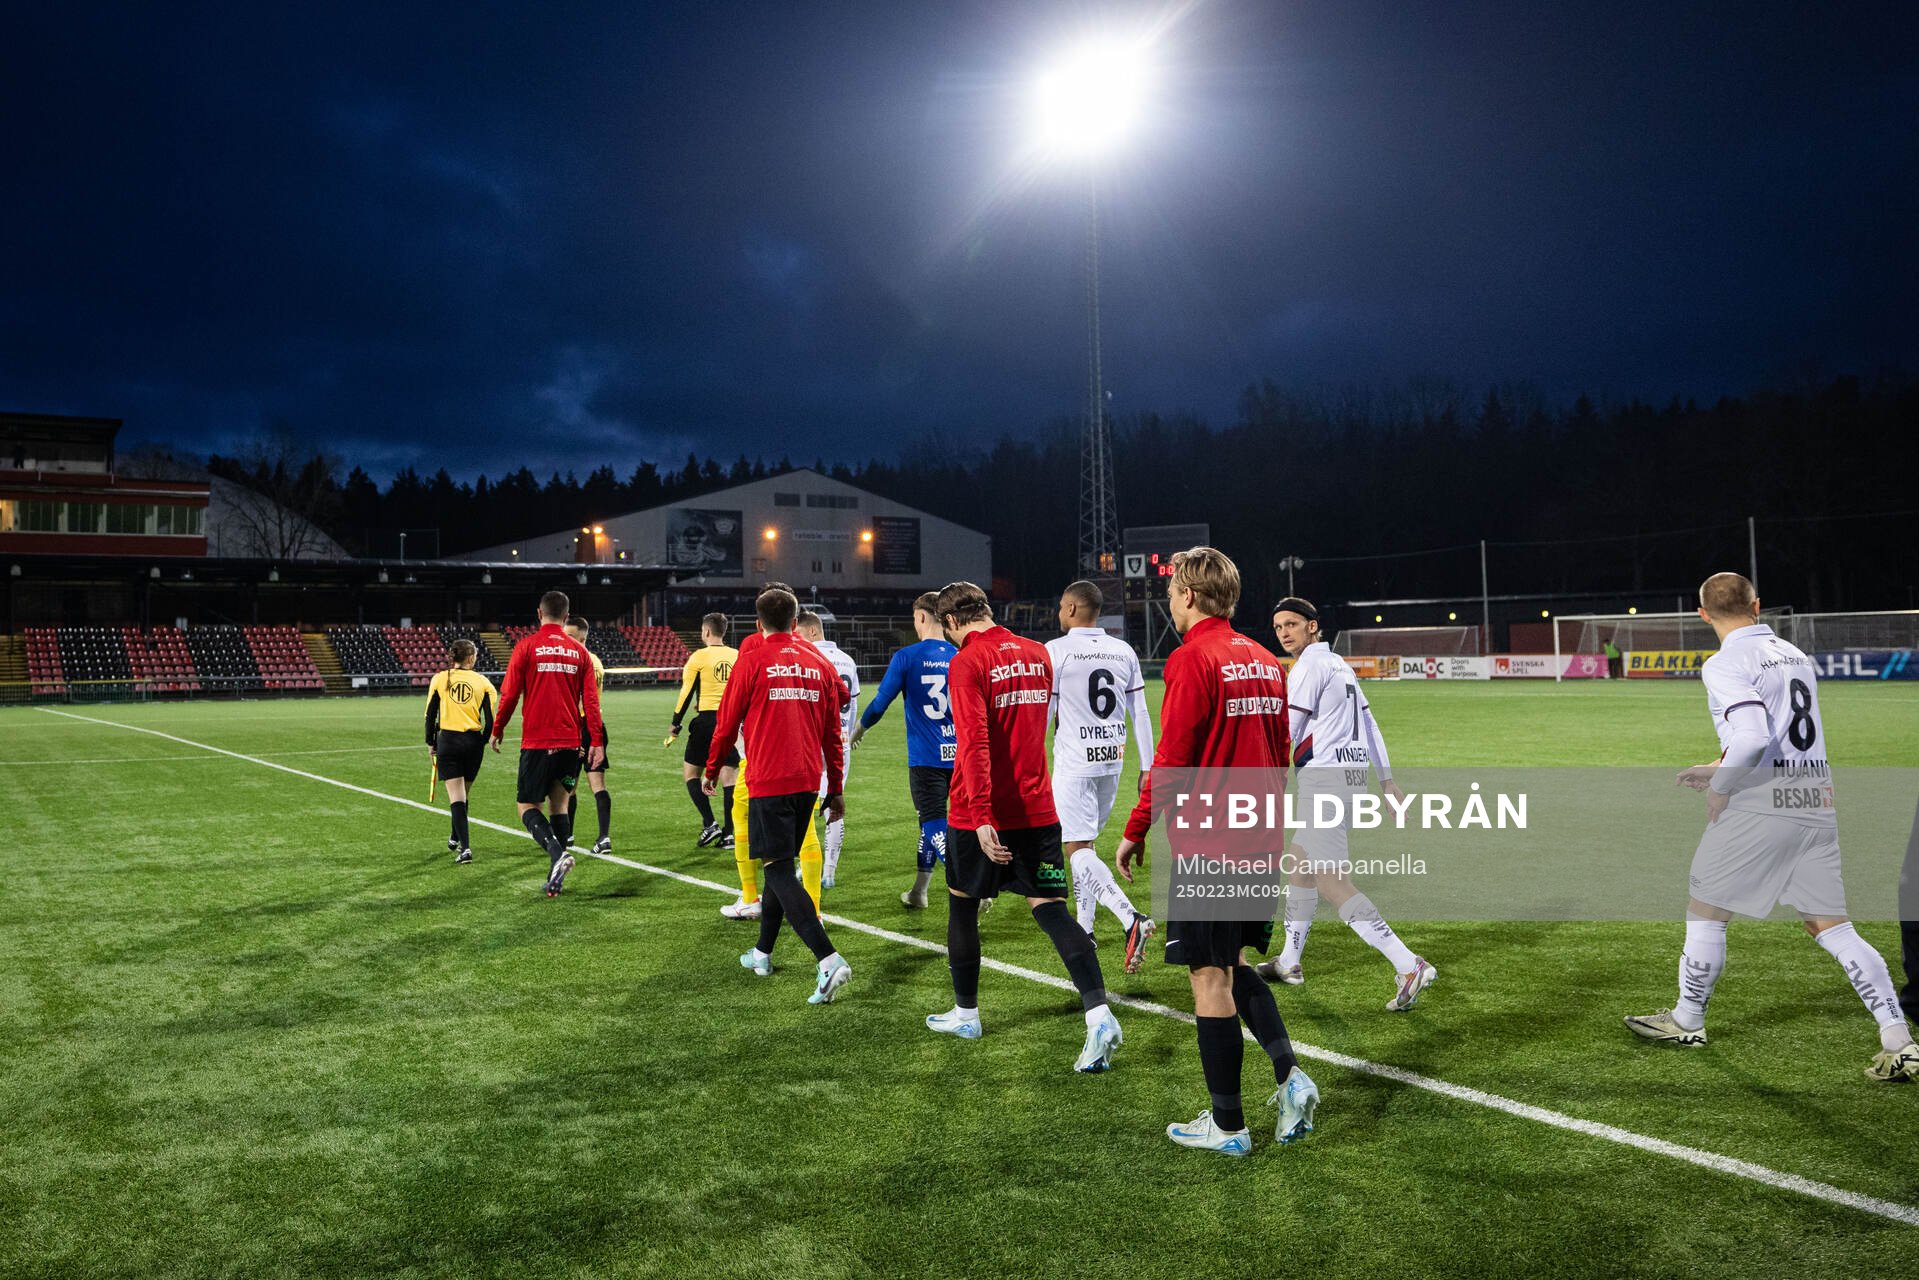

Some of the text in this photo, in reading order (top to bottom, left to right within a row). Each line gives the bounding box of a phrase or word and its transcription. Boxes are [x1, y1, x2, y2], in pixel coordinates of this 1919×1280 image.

[535, 645, 580, 659] stadium
[766, 662, 820, 680] stadium
[990, 660, 1045, 683] stadium
[1221, 659, 1282, 683] stadium
[1403, 662, 1445, 675] DALOC
[770, 688, 819, 701] BAUHAUS
[1089, 668, 1117, 720] 6
[1789, 678, 1816, 752] 8
[1086, 745, 1118, 762] BESAB
[1773, 787, 1822, 809] BESAB
